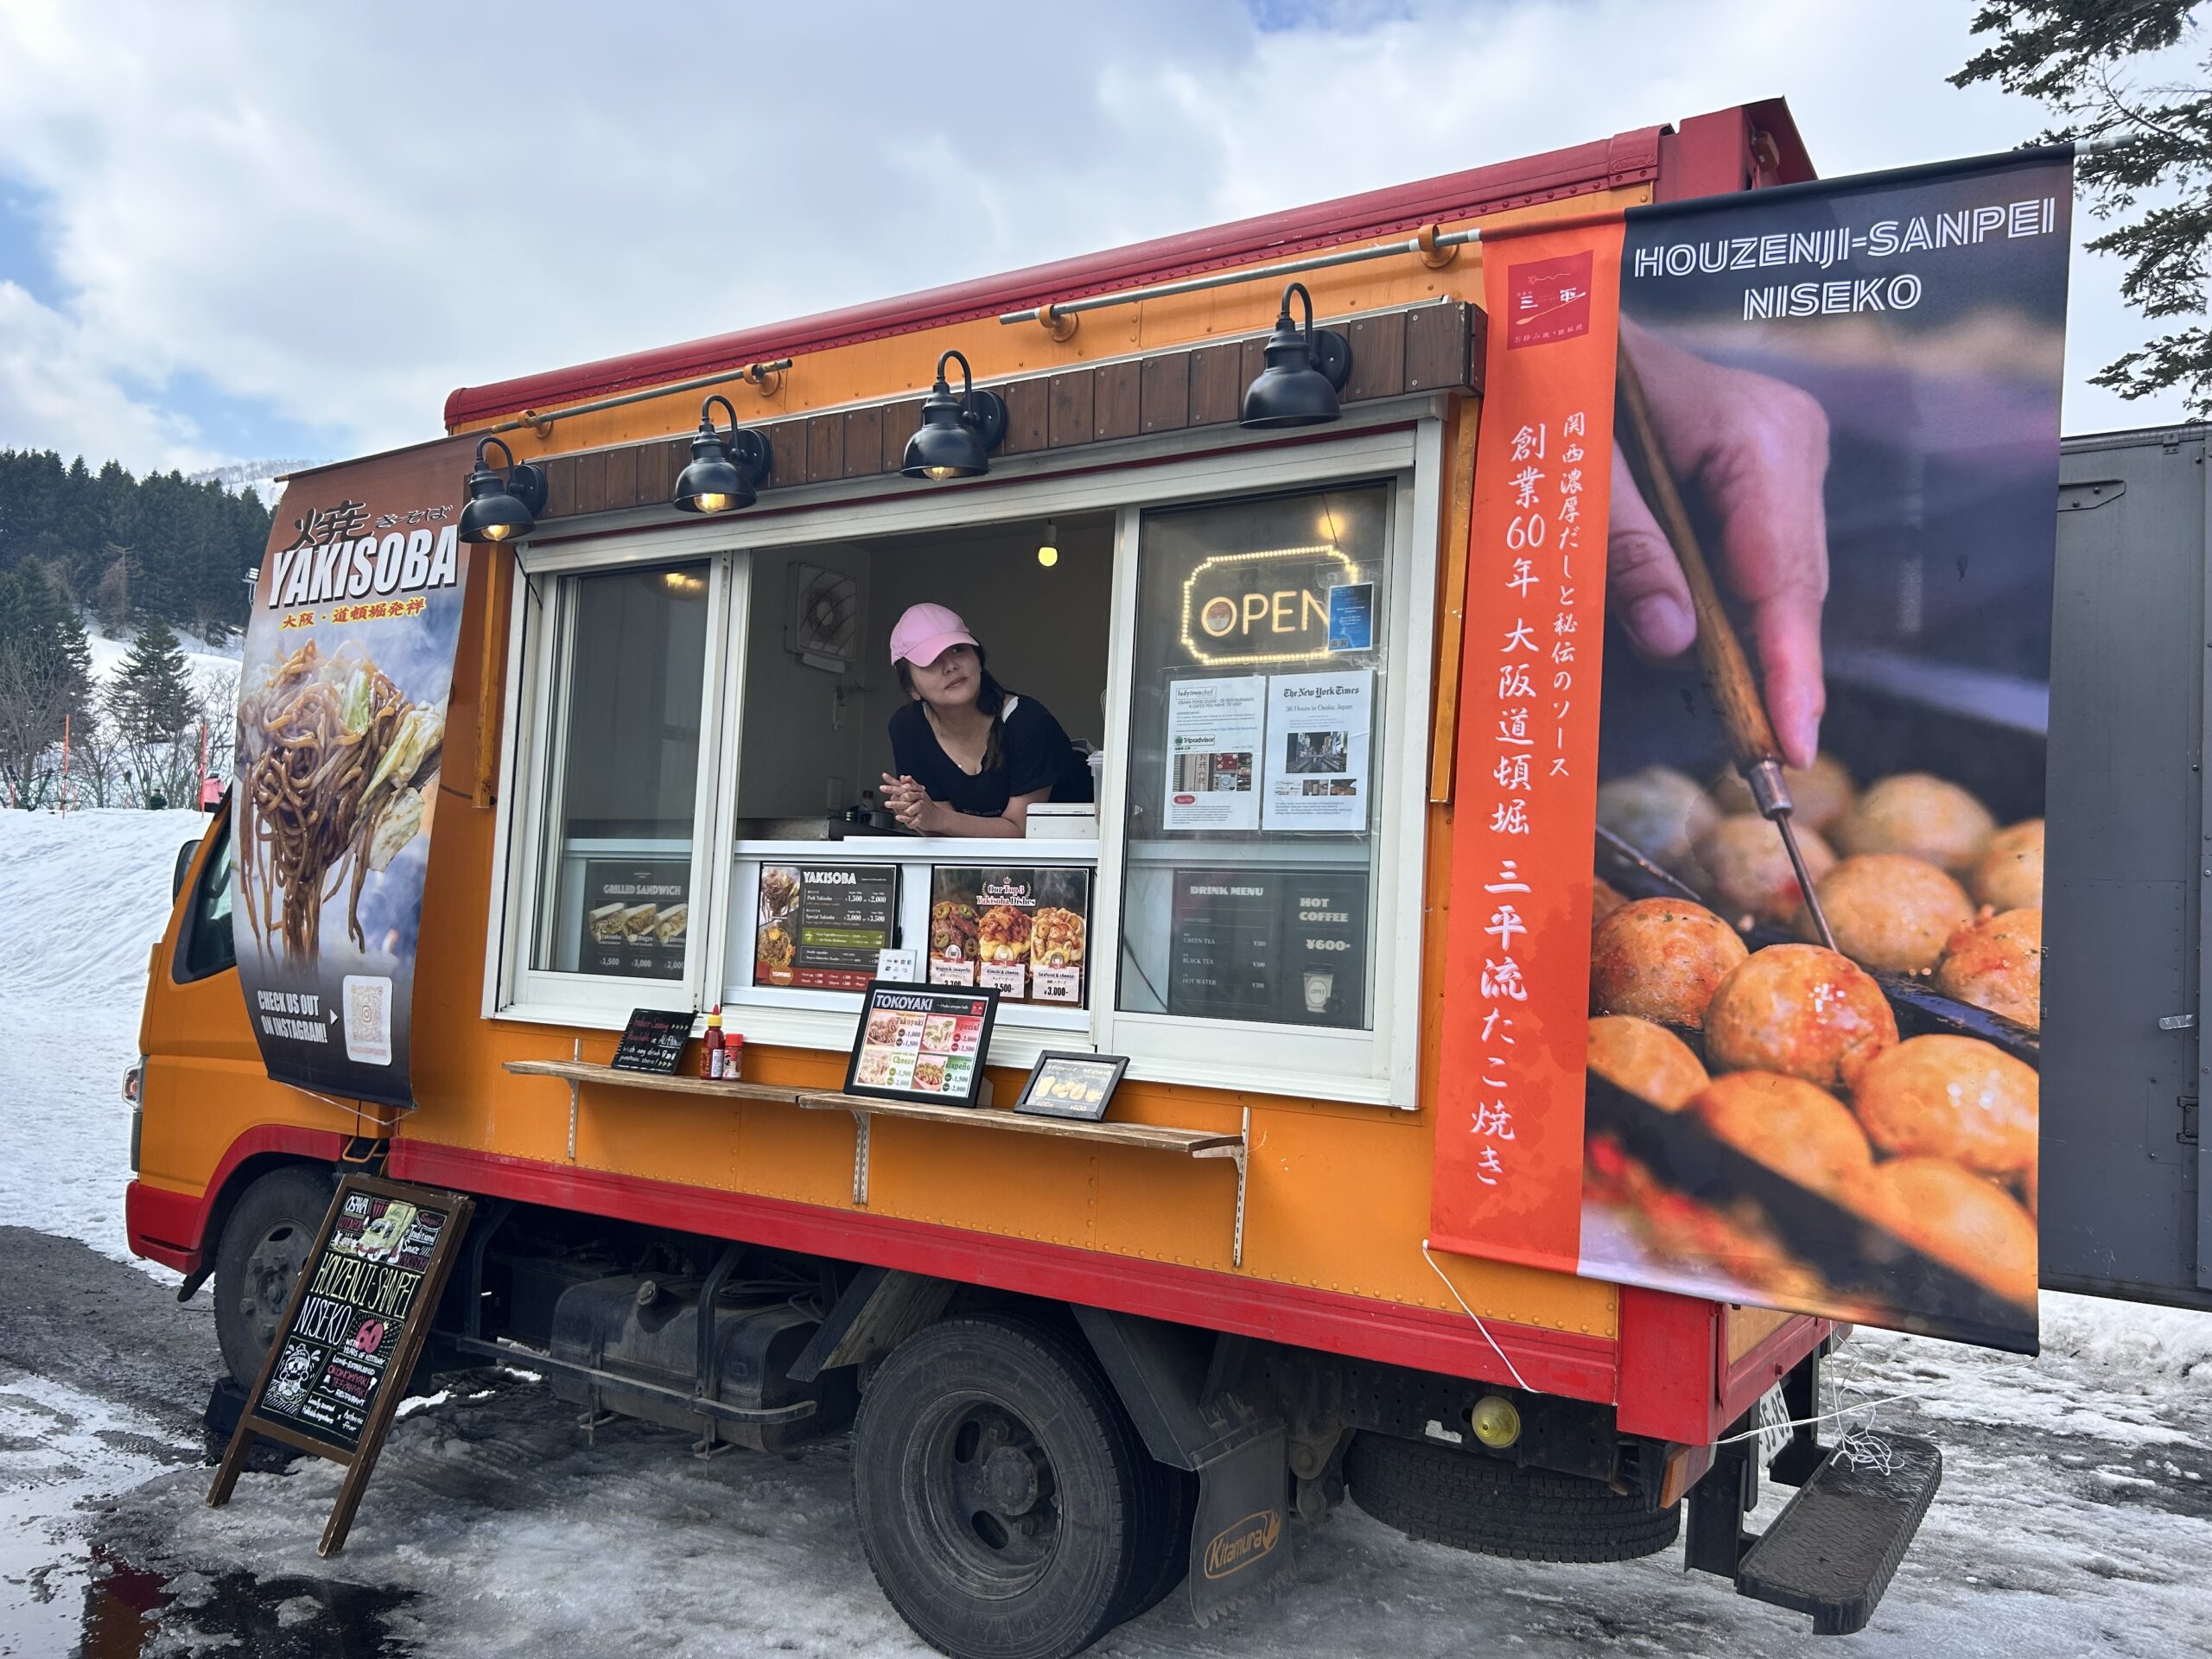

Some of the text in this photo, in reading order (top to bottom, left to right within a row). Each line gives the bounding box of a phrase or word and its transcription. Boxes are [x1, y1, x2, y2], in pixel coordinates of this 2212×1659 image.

[1634, 197, 2055, 278] HOUZENJI-SANPEI
[1743, 274, 1922, 321] NISEKO
[269, 524, 458, 608] YAKISOBA
[1549, 411, 1585, 777] 関西濃厚だしと秘伝のソース
[1201, 589, 1329, 637] OPEN
[1283, 685, 1359, 698] The New York Times
[1184, 736, 1214, 746] Tripadvisor
[1471, 423, 1547, 1185] 創業60年 大阪道頓堀 三平流たこ焼き
[804, 871, 857, 885] YAKISOBA
[603, 884, 681, 895] GRILLED SANDWICH
[988, 884, 1025, 896] Our Top 3
[1190, 886, 1264, 896] DRINK MENU
[976, 895, 1036, 906] Yakisoba Dishes
[1300, 898, 1329, 907] HOT
[1300, 912, 1348, 922] COFFEE
[257, 990, 320, 1016] CHECK US OUT
[875, 995, 933, 1011] TOKOYAKI
[261, 1015, 328, 1044] ON INSTAGRAM!
[896, 1016, 924, 1027] Takoyaki
[893, 1056, 914, 1065] Cheese
[293, 1295, 353, 1344] NISEKO
[356, 1319, 385, 1353] 60
[1210, 1529, 1262, 1573] Kitamura
